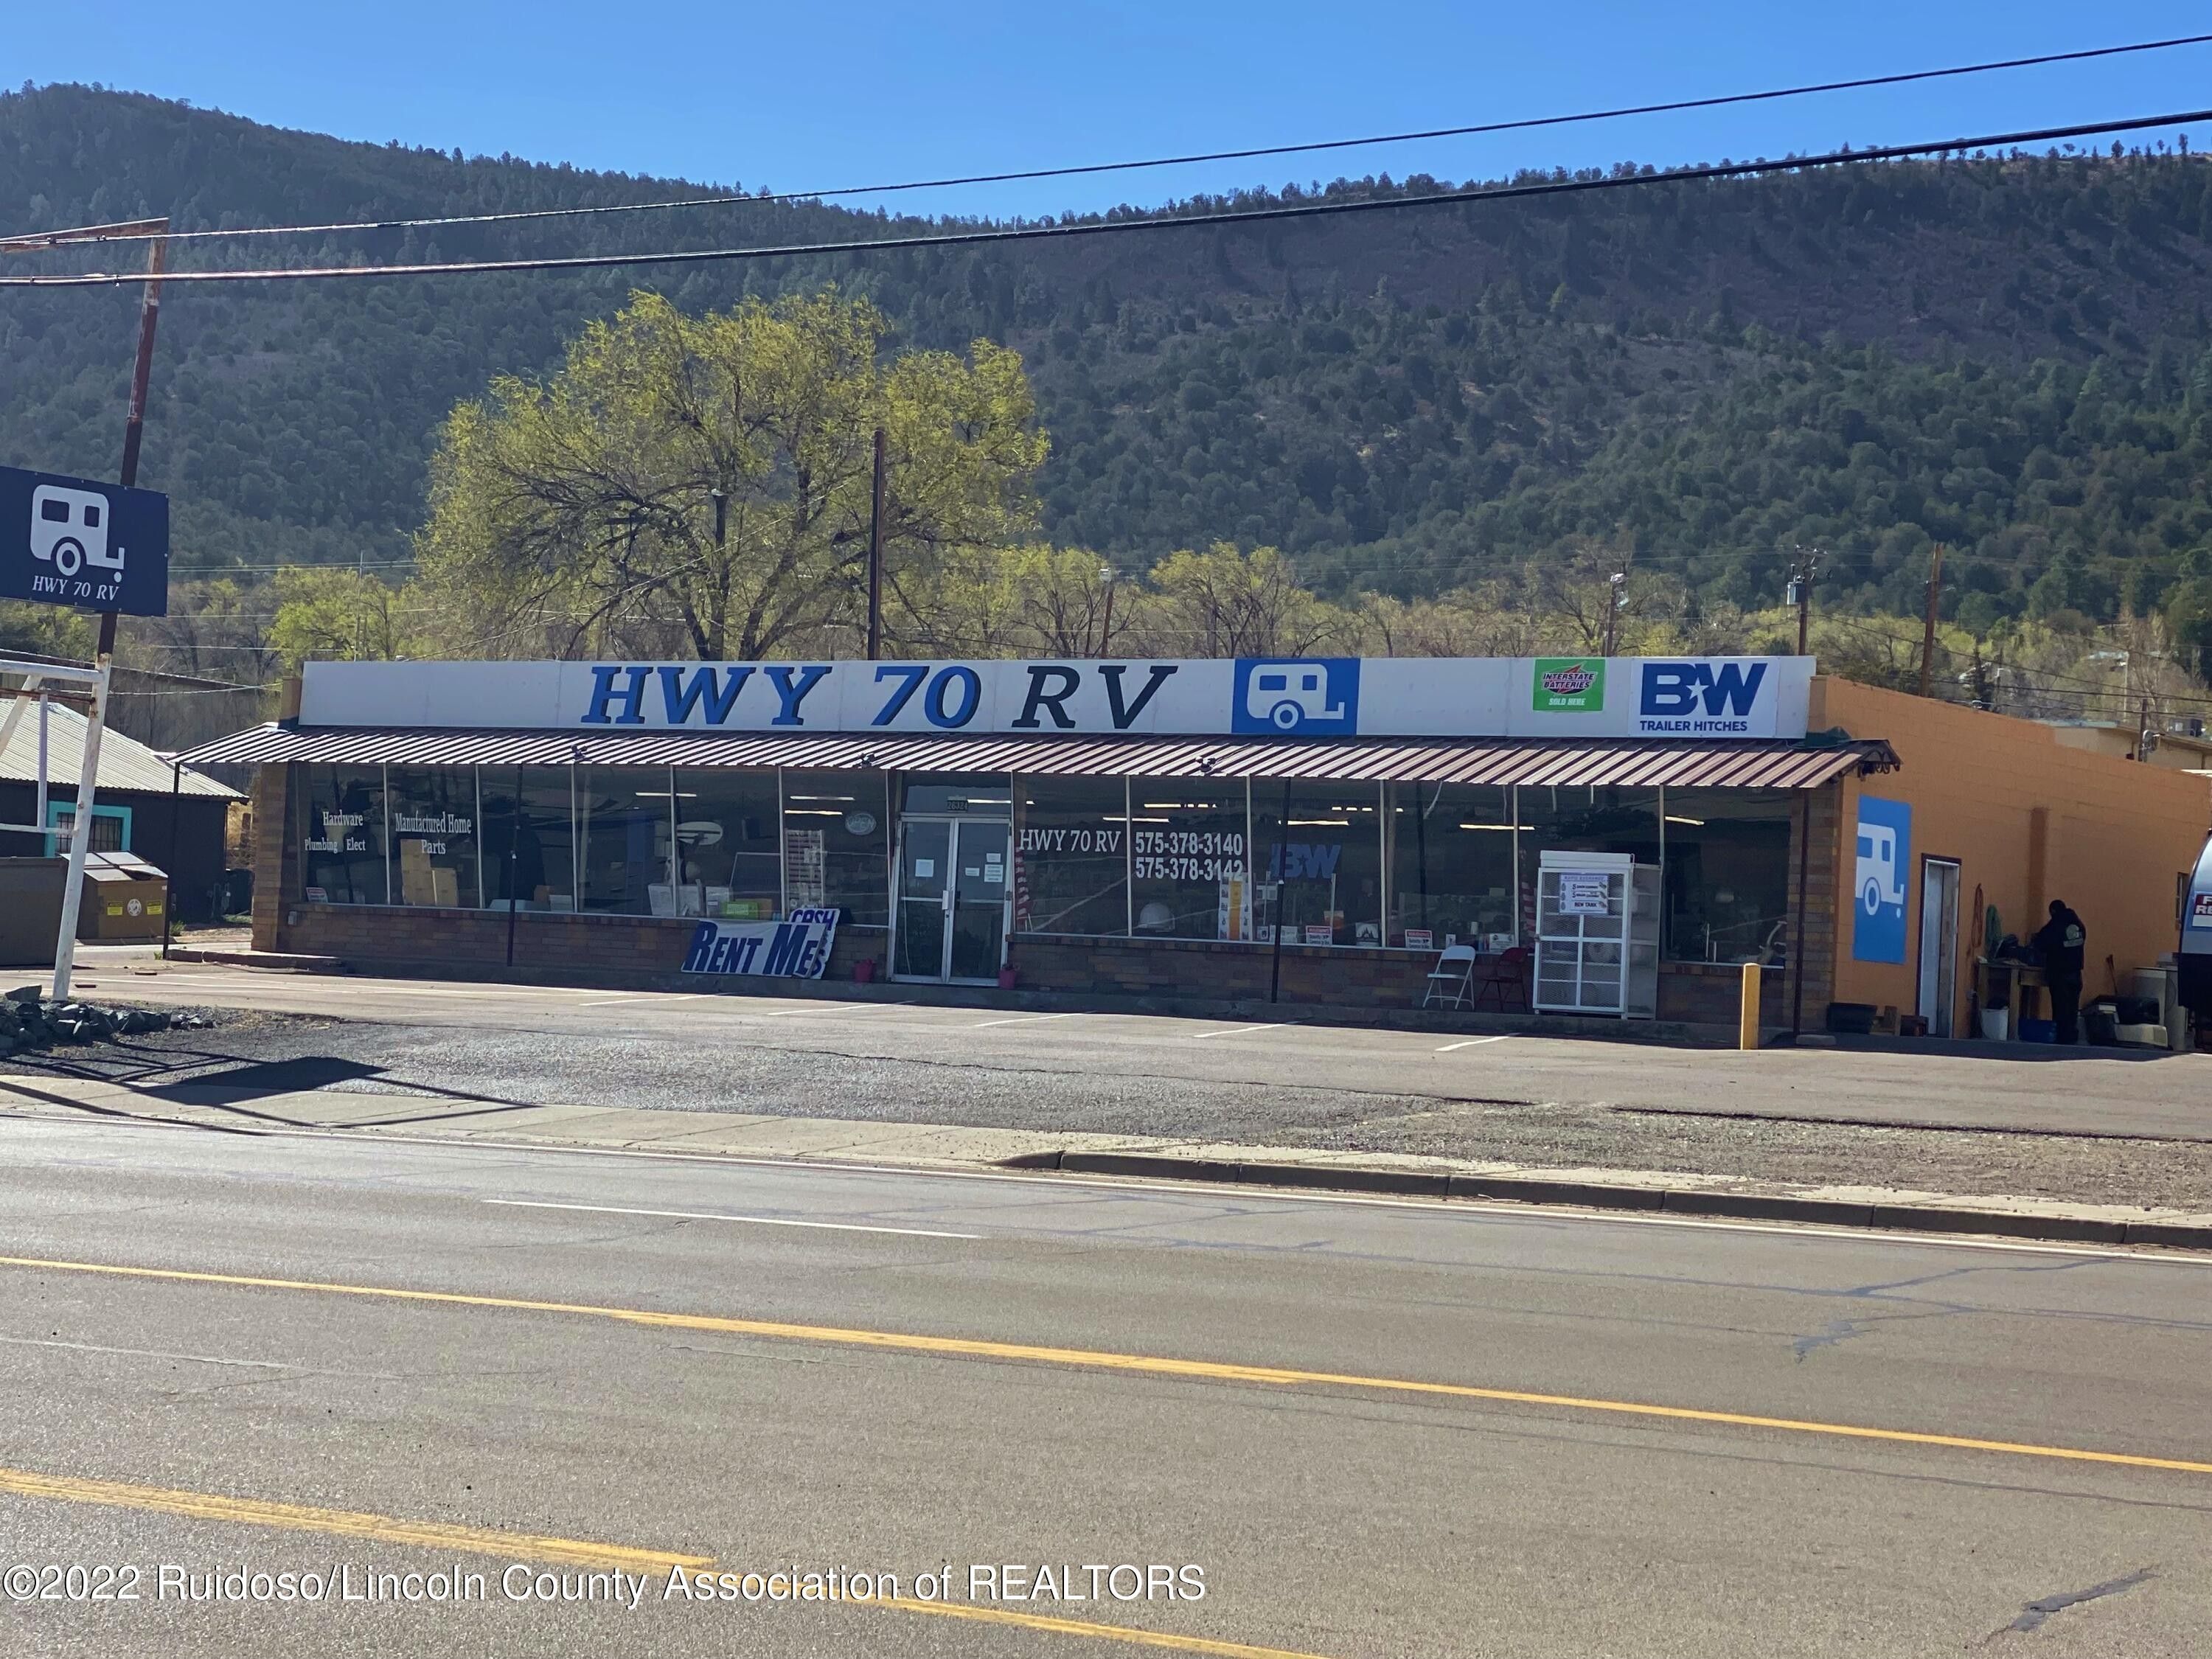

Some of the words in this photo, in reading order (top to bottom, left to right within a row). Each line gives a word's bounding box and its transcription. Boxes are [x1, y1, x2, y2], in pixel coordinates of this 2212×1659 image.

[32, 575, 67, 594] HWY
[74, 582, 91, 597] 70
[96, 584, 119, 601] RV
[1543, 672, 1595, 681] INTERSTATE
[581, 666, 832, 726] HWY
[871, 666, 982, 728] 70
[1012, 665, 1178, 729] RV
[1640, 720, 1690, 731] TRAILER
[1694, 721, 1747, 731] HITCHES
[323, 810, 364, 827] Hardware
[395, 810, 446, 833] Manufactured
[448, 813, 472, 834] Home
[305, 837, 338, 853] Plumbing
[347, 837, 366, 851] Elect
[421, 839, 446, 855] Parts
[1019, 830, 1066, 851] HWY
[1069, 830, 1091, 852] 70
[1095, 830, 1121, 852] RV
[1135, 832, 1243, 855] 575-378-3140
[1135, 857, 1244, 881] 575-378-3142
[682, 922, 765, 973] RENT
